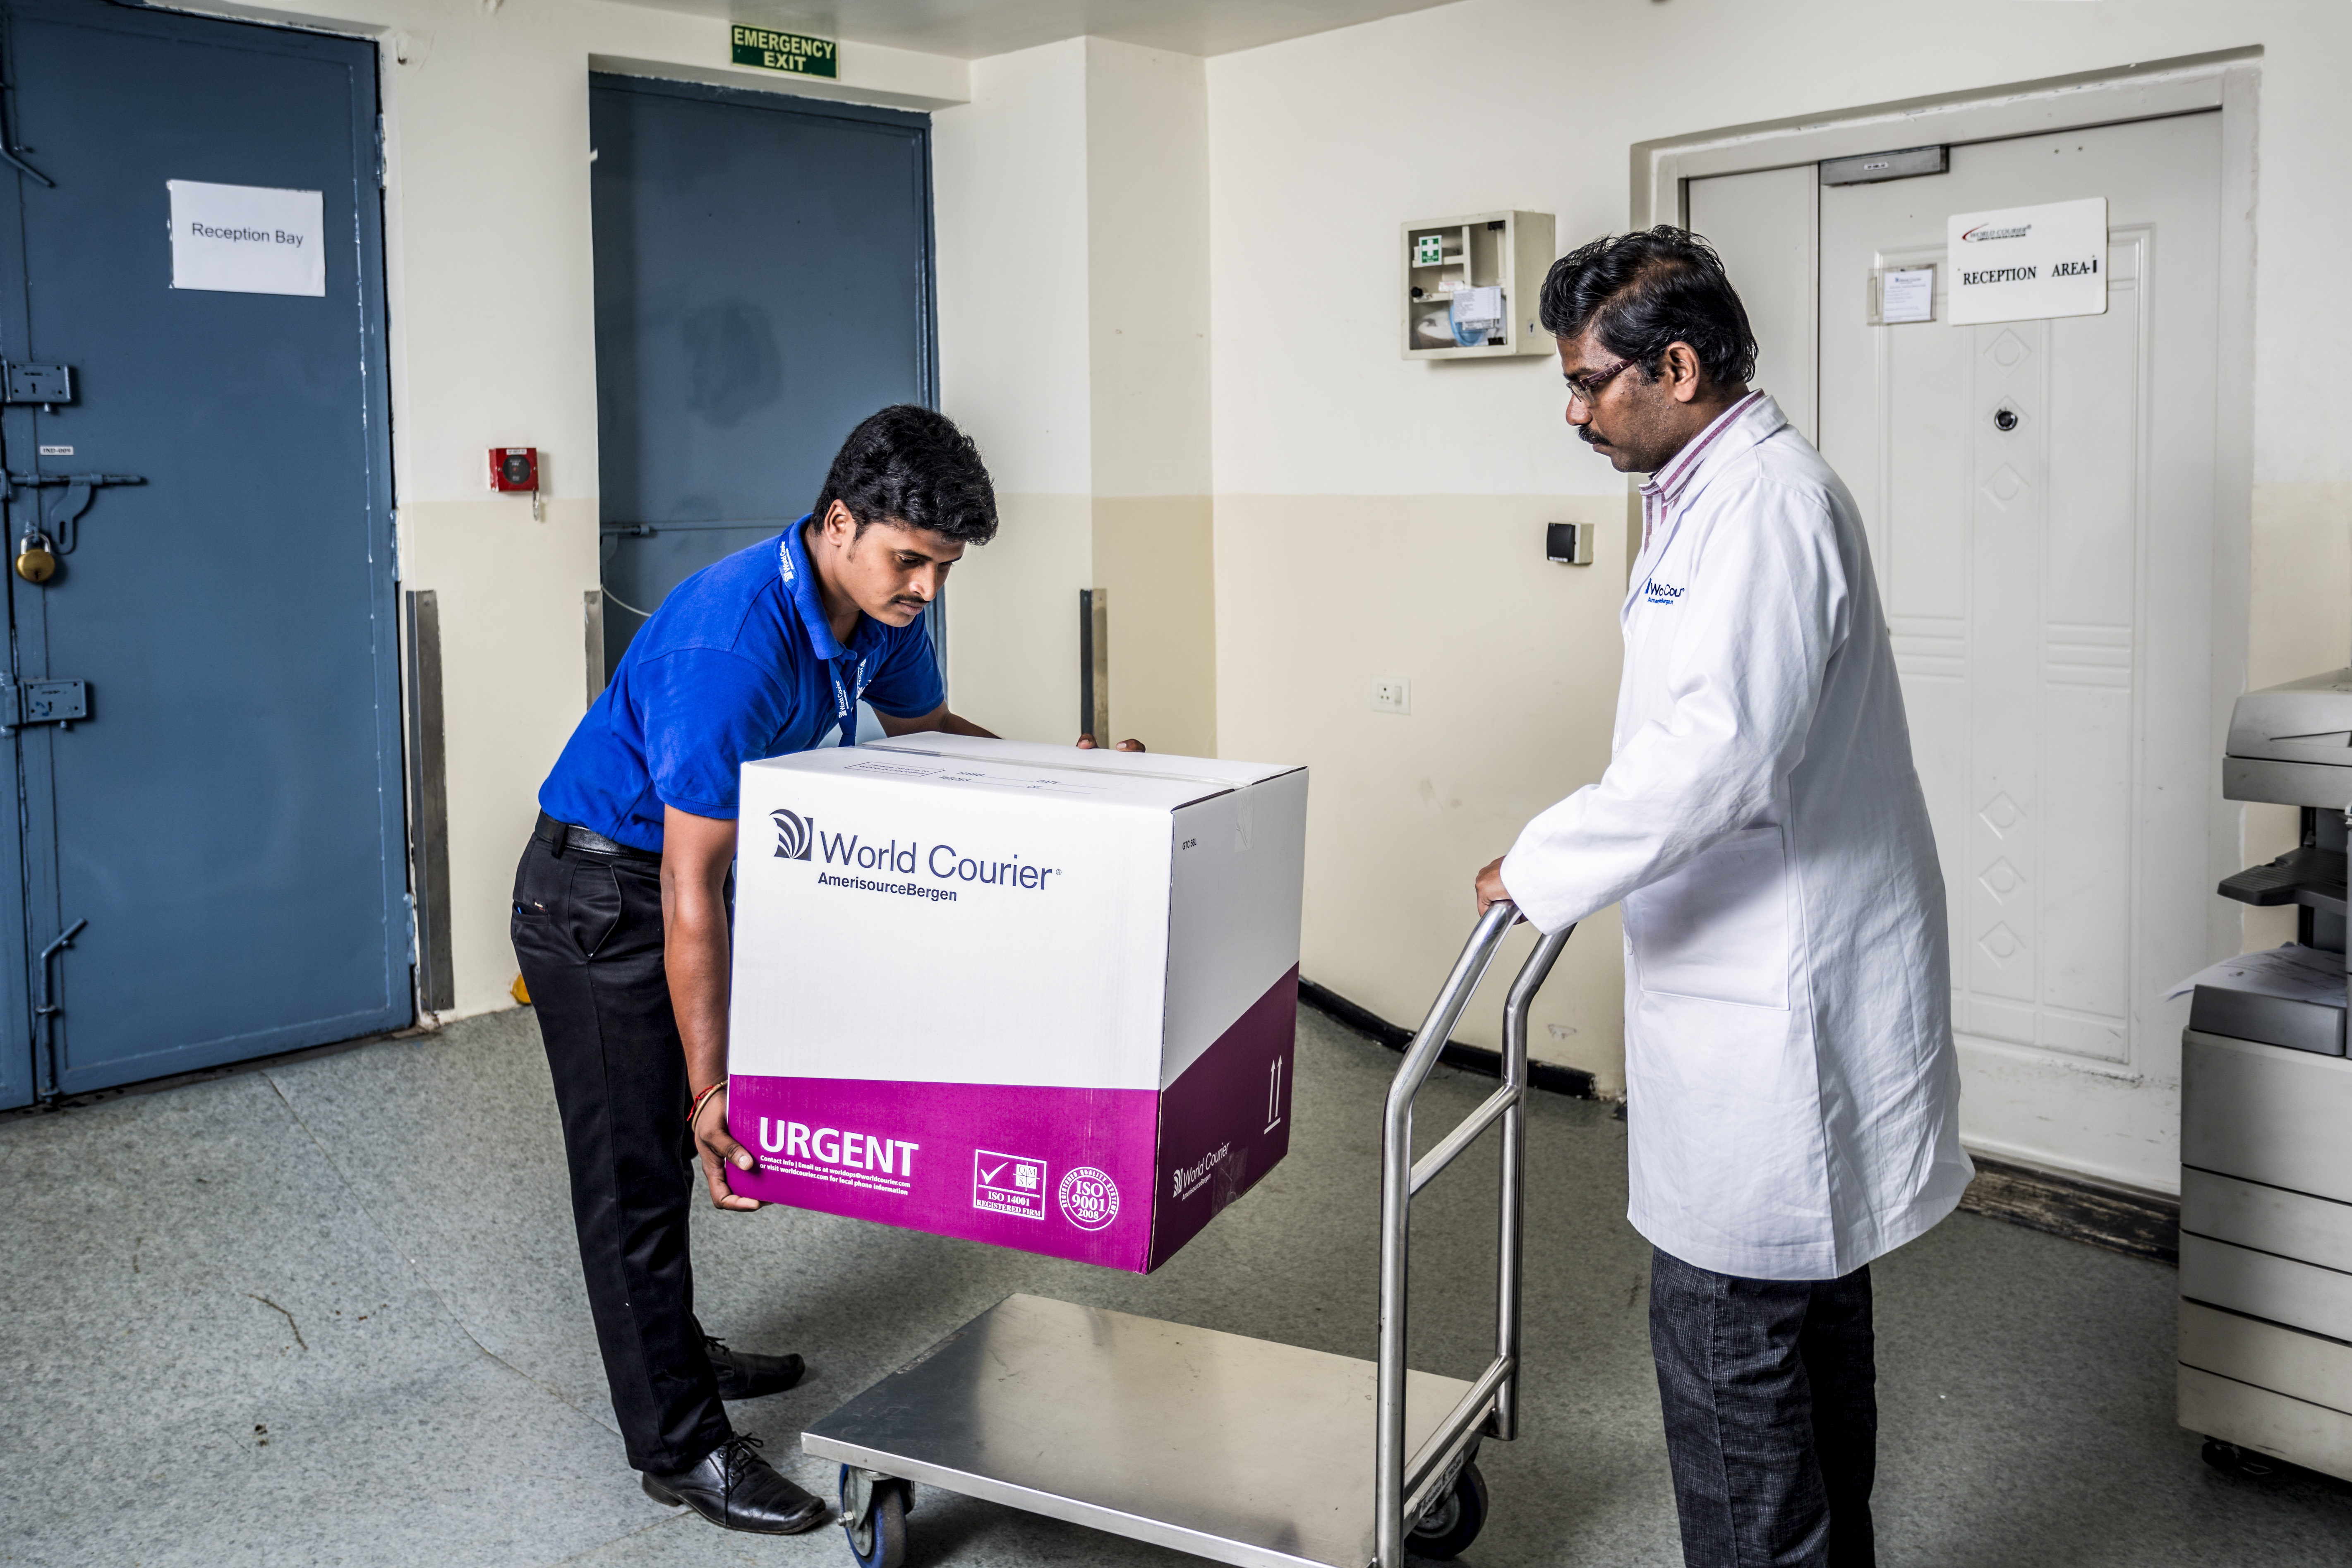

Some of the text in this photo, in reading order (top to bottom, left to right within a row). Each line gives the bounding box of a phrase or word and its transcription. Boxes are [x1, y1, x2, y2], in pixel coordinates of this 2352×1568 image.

[734, 27, 833, 59] EMERGENCY
[763, 51, 807, 71] EXIT
[192, 222, 304, 248] Reception Bay
[1963, 266, 2037, 285] RECEPTION
[820, 830, 917, 874] World
[1182, 840, 1190, 850] GTC
[818, 871, 957, 902] AmerisourceBergen
[759, 1116, 919, 1177] URGENT
[760, 1155, 782, 1164] Contact
[798, 1162, 814, 1170] Email
[829, 1168, 911, 1188] worldops@worldcourier.com
[780, 1167, 829, 1181] worldcourier.com
[839, 1177, 853, 1185] local
[854, 1180, 873, 1189] phone
[873, 1183, 908, 1195] information
[1184, 1157, 1204, 1188] World
[988, 1191, 1030, 1206] ISO 14001
[1061, 1169, 1117, 1215] REGISTERED QUALITY SYSTEMS
[1076, 1180, 1104, 1197] ISO
[1182, 1173, 1211, 1201] AmerisourceBergen
[976, 1199, 1041, 1217] REGISTERED FIRM
[1072, 1194, 1105, 1212] 9001
[1077, 1208, 1099, 1219] 2008
